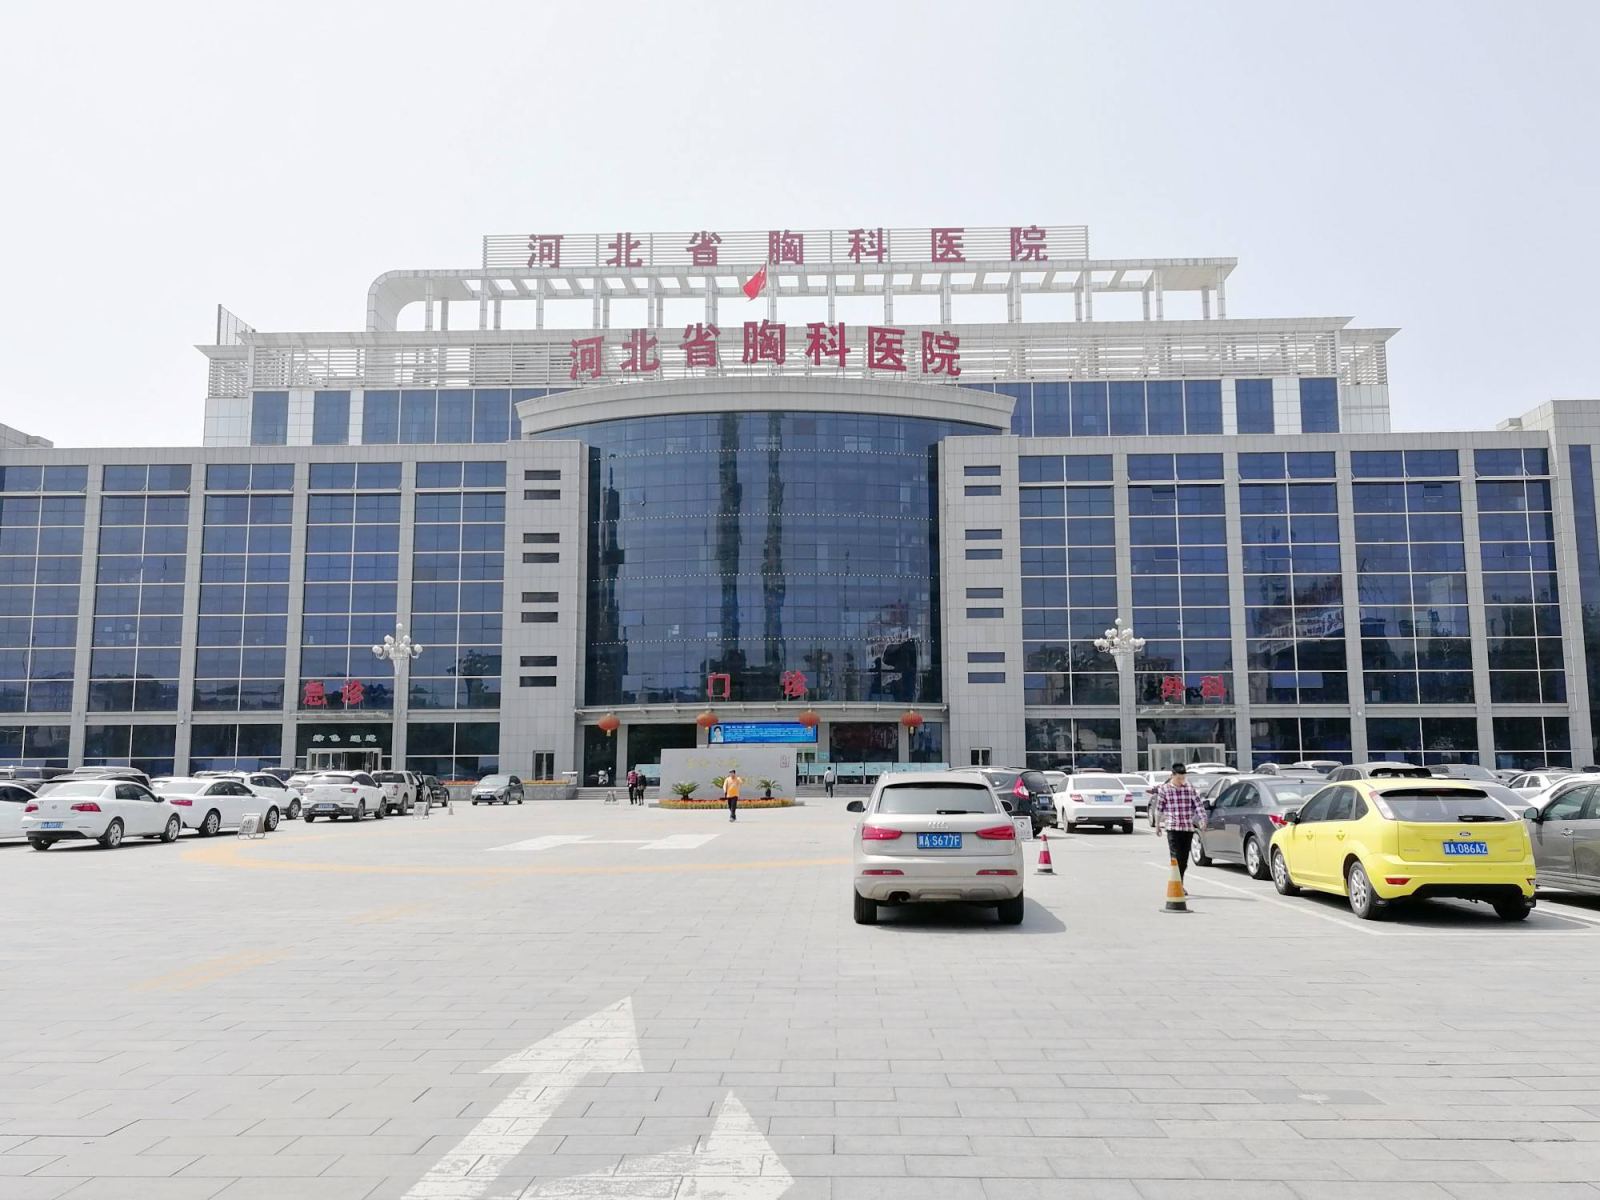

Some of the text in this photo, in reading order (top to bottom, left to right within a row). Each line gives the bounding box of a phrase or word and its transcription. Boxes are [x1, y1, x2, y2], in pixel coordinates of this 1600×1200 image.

[528, 225, 1048, 268] 河北省胸科医院
[570, 320, 963, 380] 河北省胸科医院
[303, 679, 364, 705] 急诊
